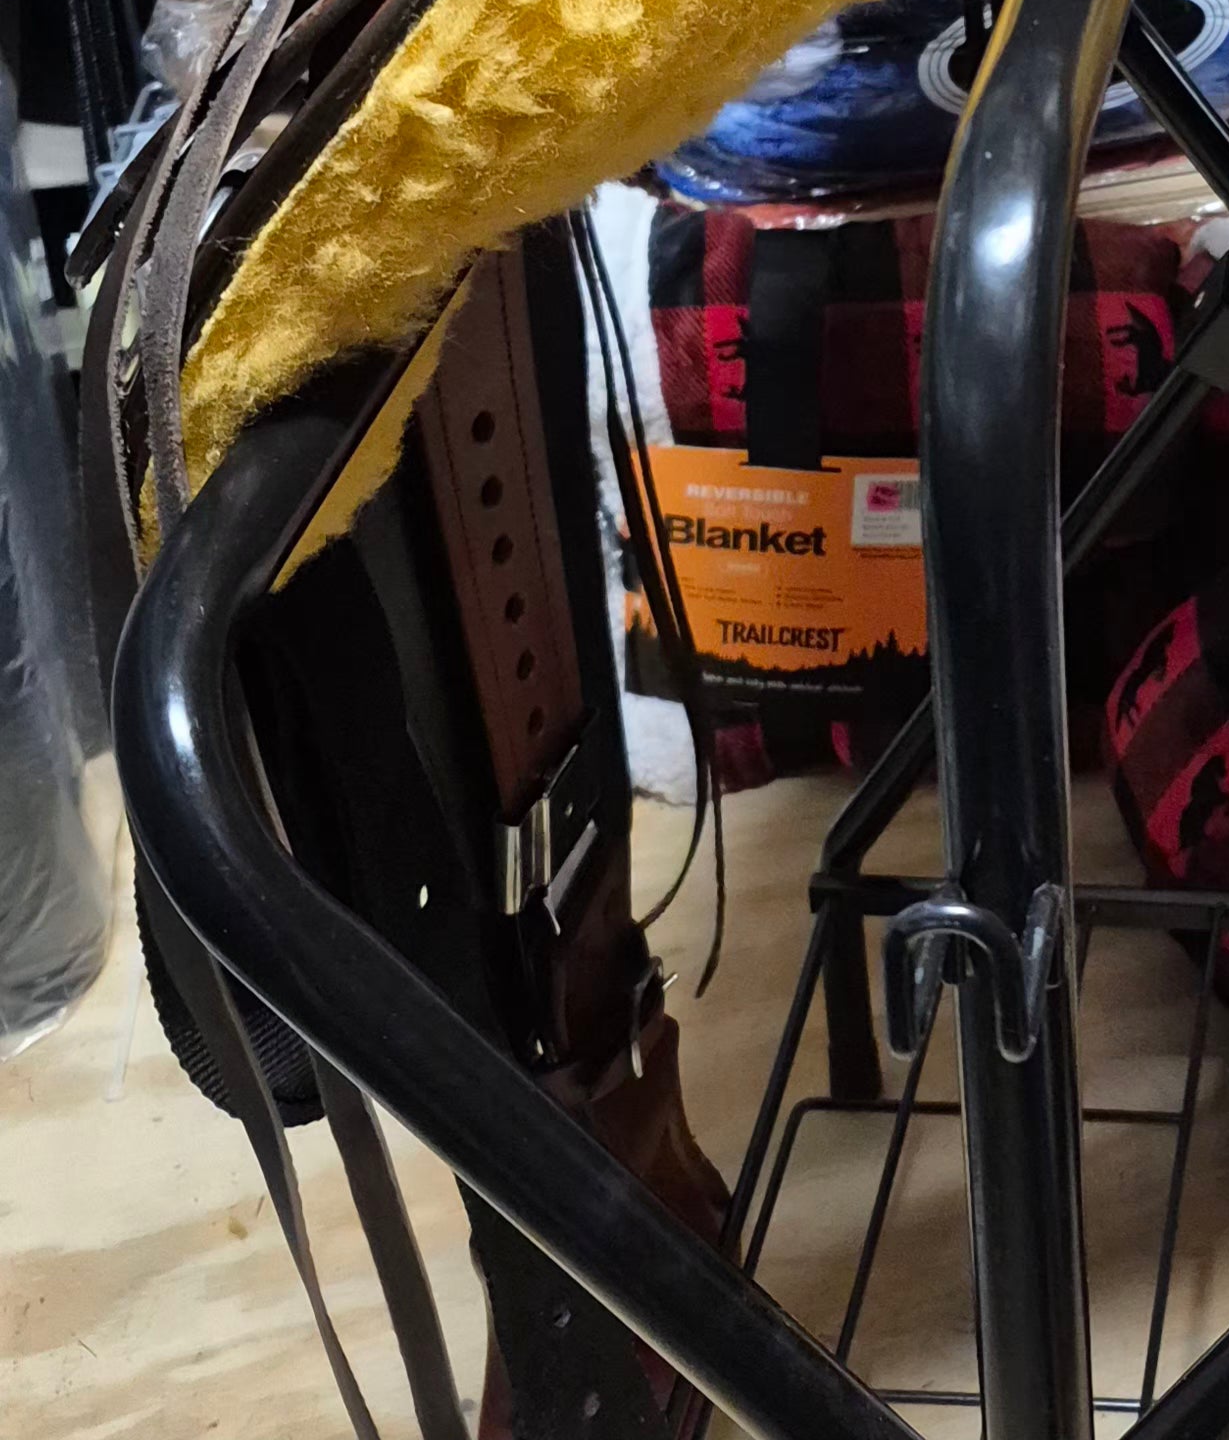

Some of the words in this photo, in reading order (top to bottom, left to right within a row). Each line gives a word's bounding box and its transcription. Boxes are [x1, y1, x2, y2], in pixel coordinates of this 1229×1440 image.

[686, 482, 810, 506] REVERSIBLE
[663, 512, 827, 557] Blanket
[716, 618, 846, 653] TRAILCREST
